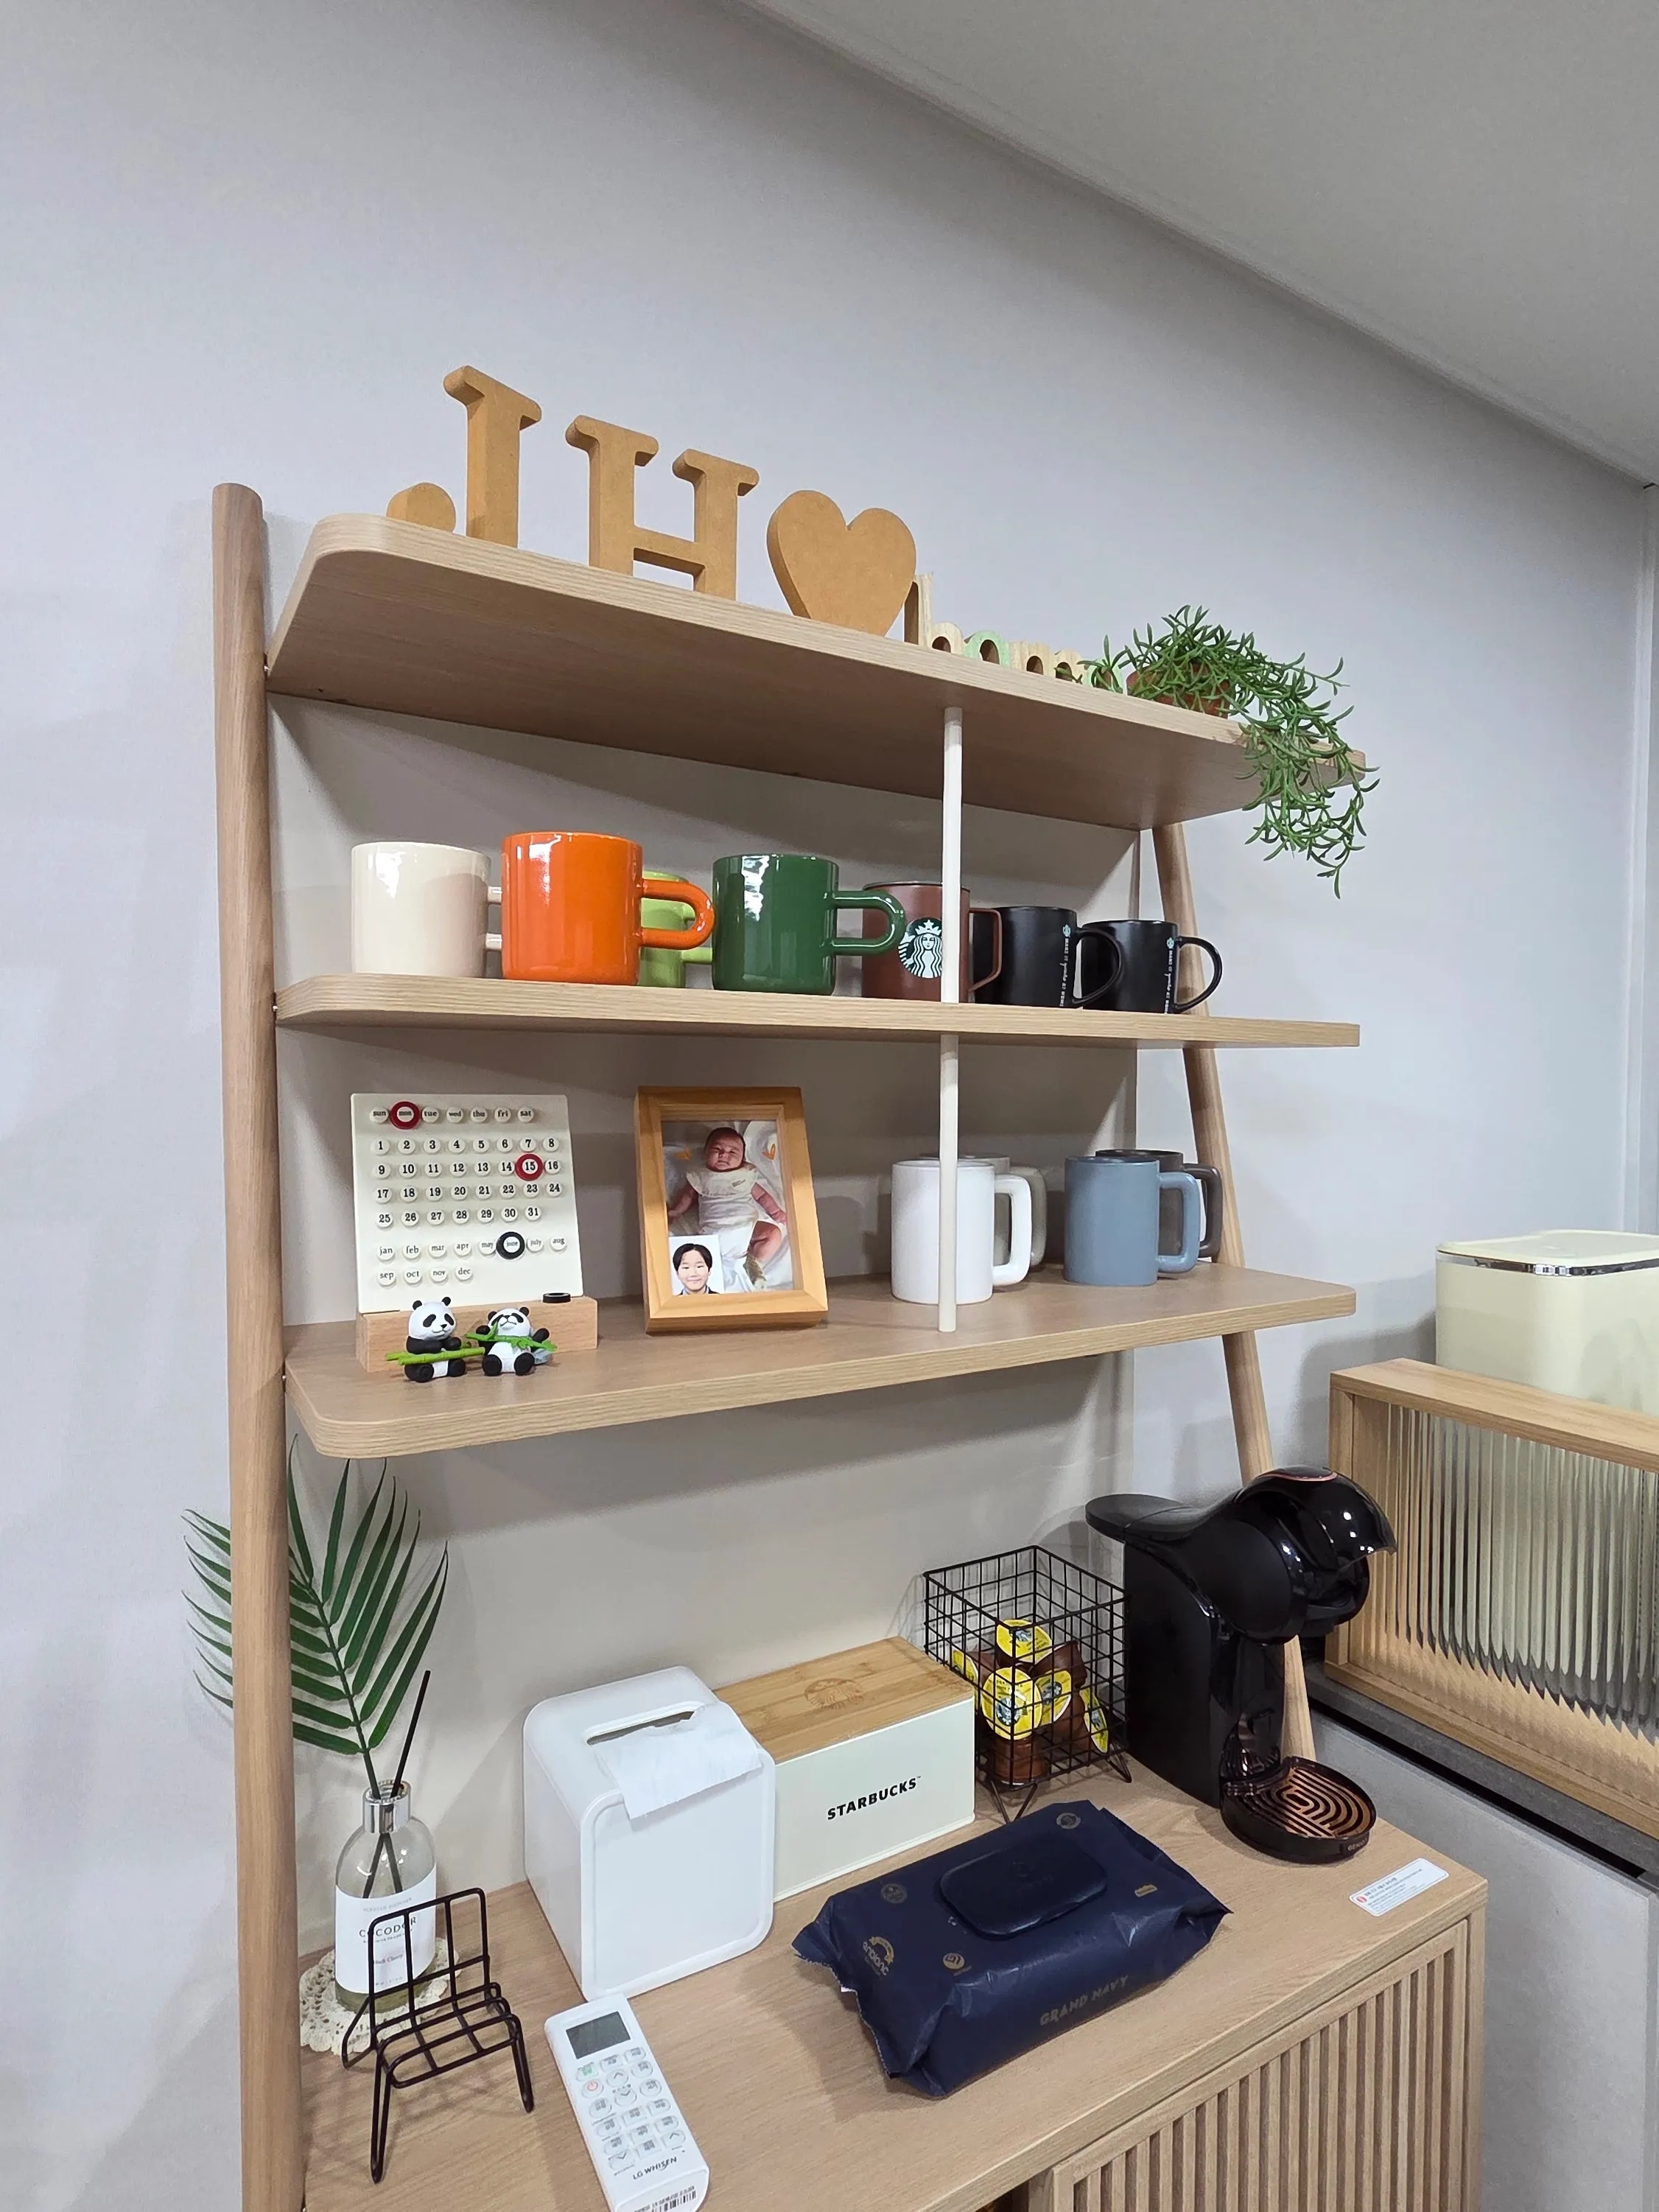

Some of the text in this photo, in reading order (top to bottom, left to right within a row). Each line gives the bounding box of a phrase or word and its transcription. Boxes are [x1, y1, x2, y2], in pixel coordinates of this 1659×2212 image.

[473, 1110, 485, 1118] thu
[497, 1109, 508, 1118] fri
[379, 1138, 555, 1150] 1 2 3 4 5 6 7 8
[378, 1161, 558, 1175] 9 10 11 12 13 14 15 16
[377, 1183, 561, 1198] 17 18 19 20 21 22 23 24
[379, 1207, 539, 1223] 25 26 27 28 29 30 31
[379, 1246, 393, 1256] jan
[406, 1245, 419, 1254] feb
[530, 1239, 542, 1248] july
[379, 1272, 394, 1280] sep
[457, 1267, 471, 1275] dec
[827, 1777, 917, 1821] STARBUCKS
[359, 1917, 416, 1938] CCODR
[1040, 1975, 1129, 2026] GRAND NAVY
[633, 2170, 643, 2180] LG
[644, 2156, 677, 2175] WHISEN
